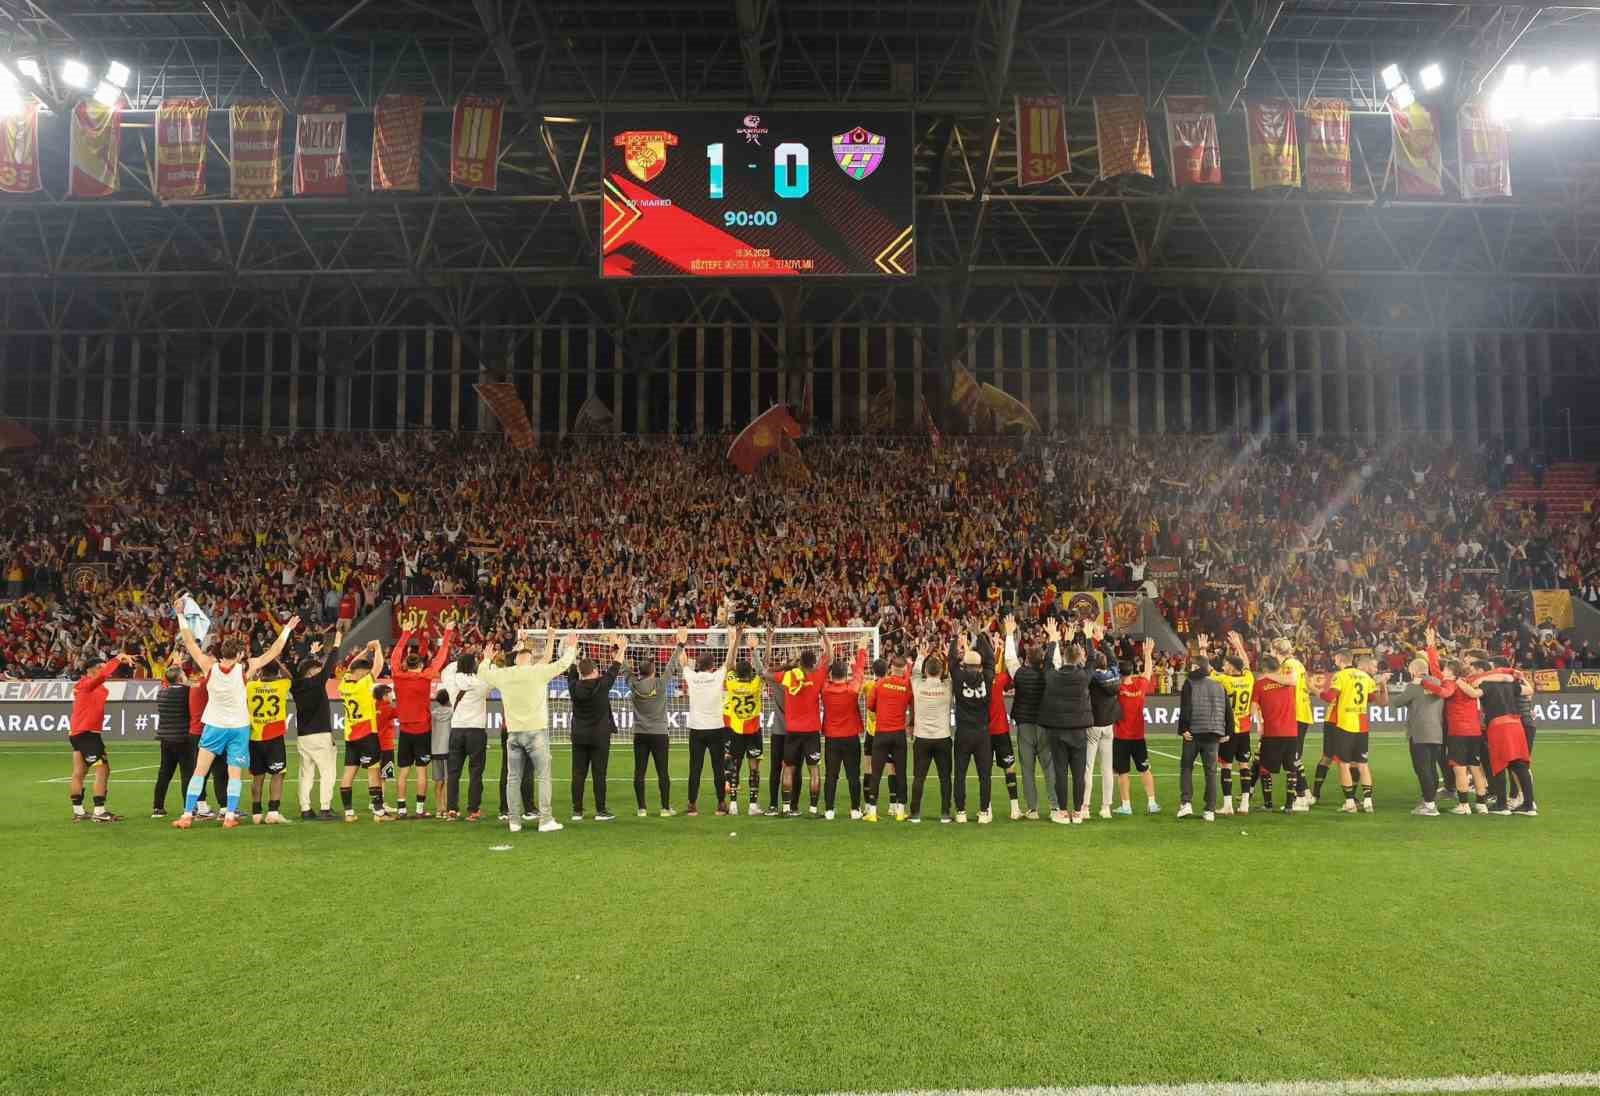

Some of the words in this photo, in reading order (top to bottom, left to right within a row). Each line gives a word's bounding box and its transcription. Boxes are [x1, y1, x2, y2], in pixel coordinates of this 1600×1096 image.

[707, 143, 723, 198] 1
[774, 143, 809, 198] 0
[724, 211, 778, 226] 90:00
[1232, 690, 1250, 712] 19
[1353, 682, 1364, 705] 3
[252, 695, 281, 718] 23
[732, 695, 756, 716] 25
